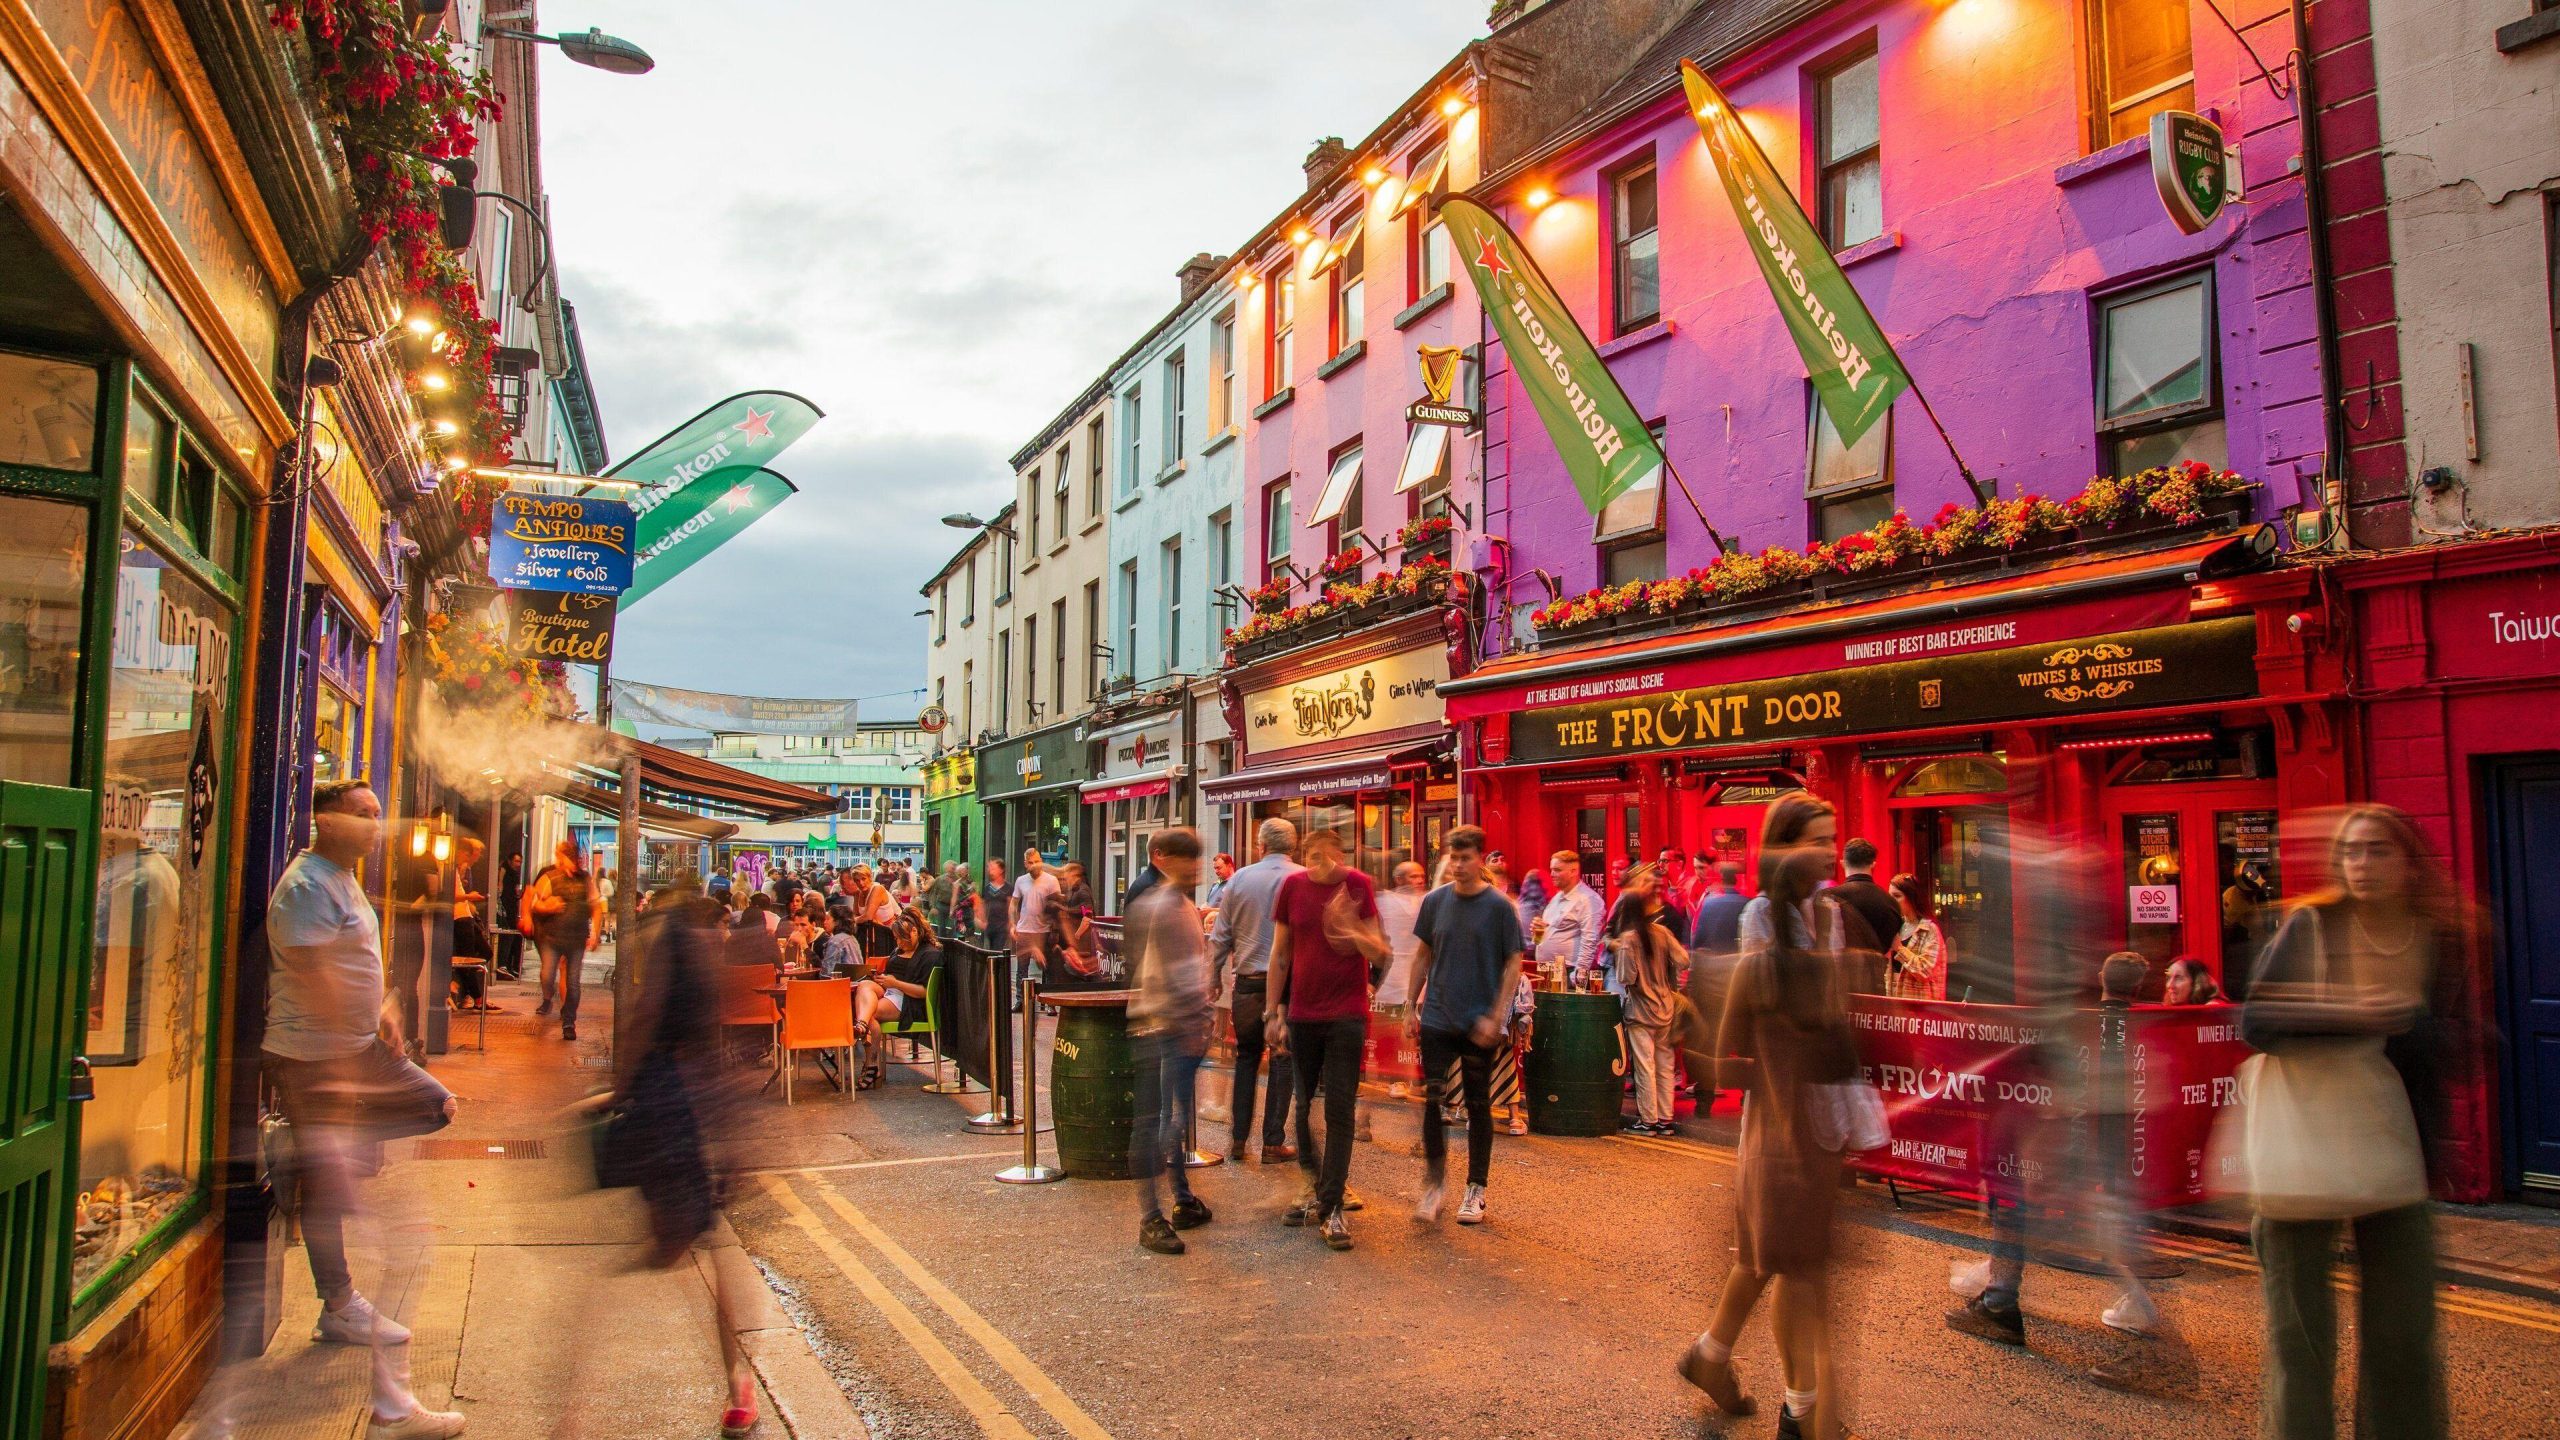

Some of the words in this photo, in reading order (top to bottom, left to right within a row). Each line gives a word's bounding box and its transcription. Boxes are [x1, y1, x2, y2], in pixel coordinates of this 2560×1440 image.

[2184, 129, 2212, 145] Heineken
[2179, 140, 2202, 157] RUGBY
[2204, 148, 2220, 164] CLUB
[1415, 405, 1470, 422] GUINNESS
[505, 496, 583, 519] TEMPO
[514, 517, 625, 542] ANTIQUES
[530, 544, 600, 564] Jewellery
[515, 561, 561, 578] Silver
[573, 566, 608, 581] Gold
[520, 608, 590, 631] Boutique
[513, 624, 608, 660] Hotel
[1845, 641, 1883, 661] WINNER
[1884, 638, 1898, 656] OF
[1899, 635, 1925, 654] BEST
[1926, 632, 1948, 650] BAR
[1950, 622, 2016, 646] EXPERIENCE
[2018, 669, 2066, 687] WINES
[2070, 668, 2081, 682] &
[2085, 658, 2163, 680] WHISKIES
[1389, 684, 1405, 698] Gins
[1406, 682, 1412, 694] &
[1412, 677, 1435, 697] Wines
[1525, 691, 1535, 705] AT
[1536, 690, 1548, 703] THE
[1549, 686, 1570, 701] HEART
[1570, 685, 1580, 698] OF
[1580, 680, 1614, 698] GALWAY'S
[1615, 677, 1639, 693] SOCIAL
[1641, 672, 1664, 688] SCENE
[1557, 719, 1598, 746] THE
[1611, 691, 1749, 748] FRONT
[1764, 690, 1842, 725] DOOR
[1118, 746, 1136, 762] PIZZA
[1145, 737, 1170, 756] AMORE
[1300, 781, 1322, 793] Galway's
[1322, 778, 1340, 790] Award
[1340, 777, 1362, 788] Winning
[1362, 775, 1373, 786] Gin
[1373, 774, 1386, 784] Bar
[2140, 834, 2169, 844] KITCHEN
[2140, 845, 2169, 856] PORTER
[1590, 873, 1605, 887] THE
[1368, 1000, 1386, 1013] HE
[1855, 1012, 1873, 1029] THE
[1875, 1015, 1906, 1033] HEART
[1908, 1017, 1922, 1035] OF
[1923, 1019, 1976, 1041] GALWAY'S
[1978, 1024, 2016, 1044] SOCIAL
[2197, 1025, 2225, 1043] WINNER
[2225, 1024, 2235, 1041] OF
[1397, 1050, 1412, 1064] BAR
[1879, 1060, 1986, 1103] FRONT
[1997, 1081, 2053, 1106] DOOR
[2181, 1083, 2207, 1105] THE
[2131, 1043, 2146, 1177] GUINNESS
[1891, 1139, 1911, 1158] BAR
[1912, 1141, 1919, 1149] OF
[1921, 1143, 1946, 1164] YEAR
[1946, 1147, 1967, 1159] AWARDS
[1912, 1150, 1922, 1160] THE
[1997, 1161, 2044, 1181] QUARTER
[2009, 1153, 2042, 1172] LATIN
